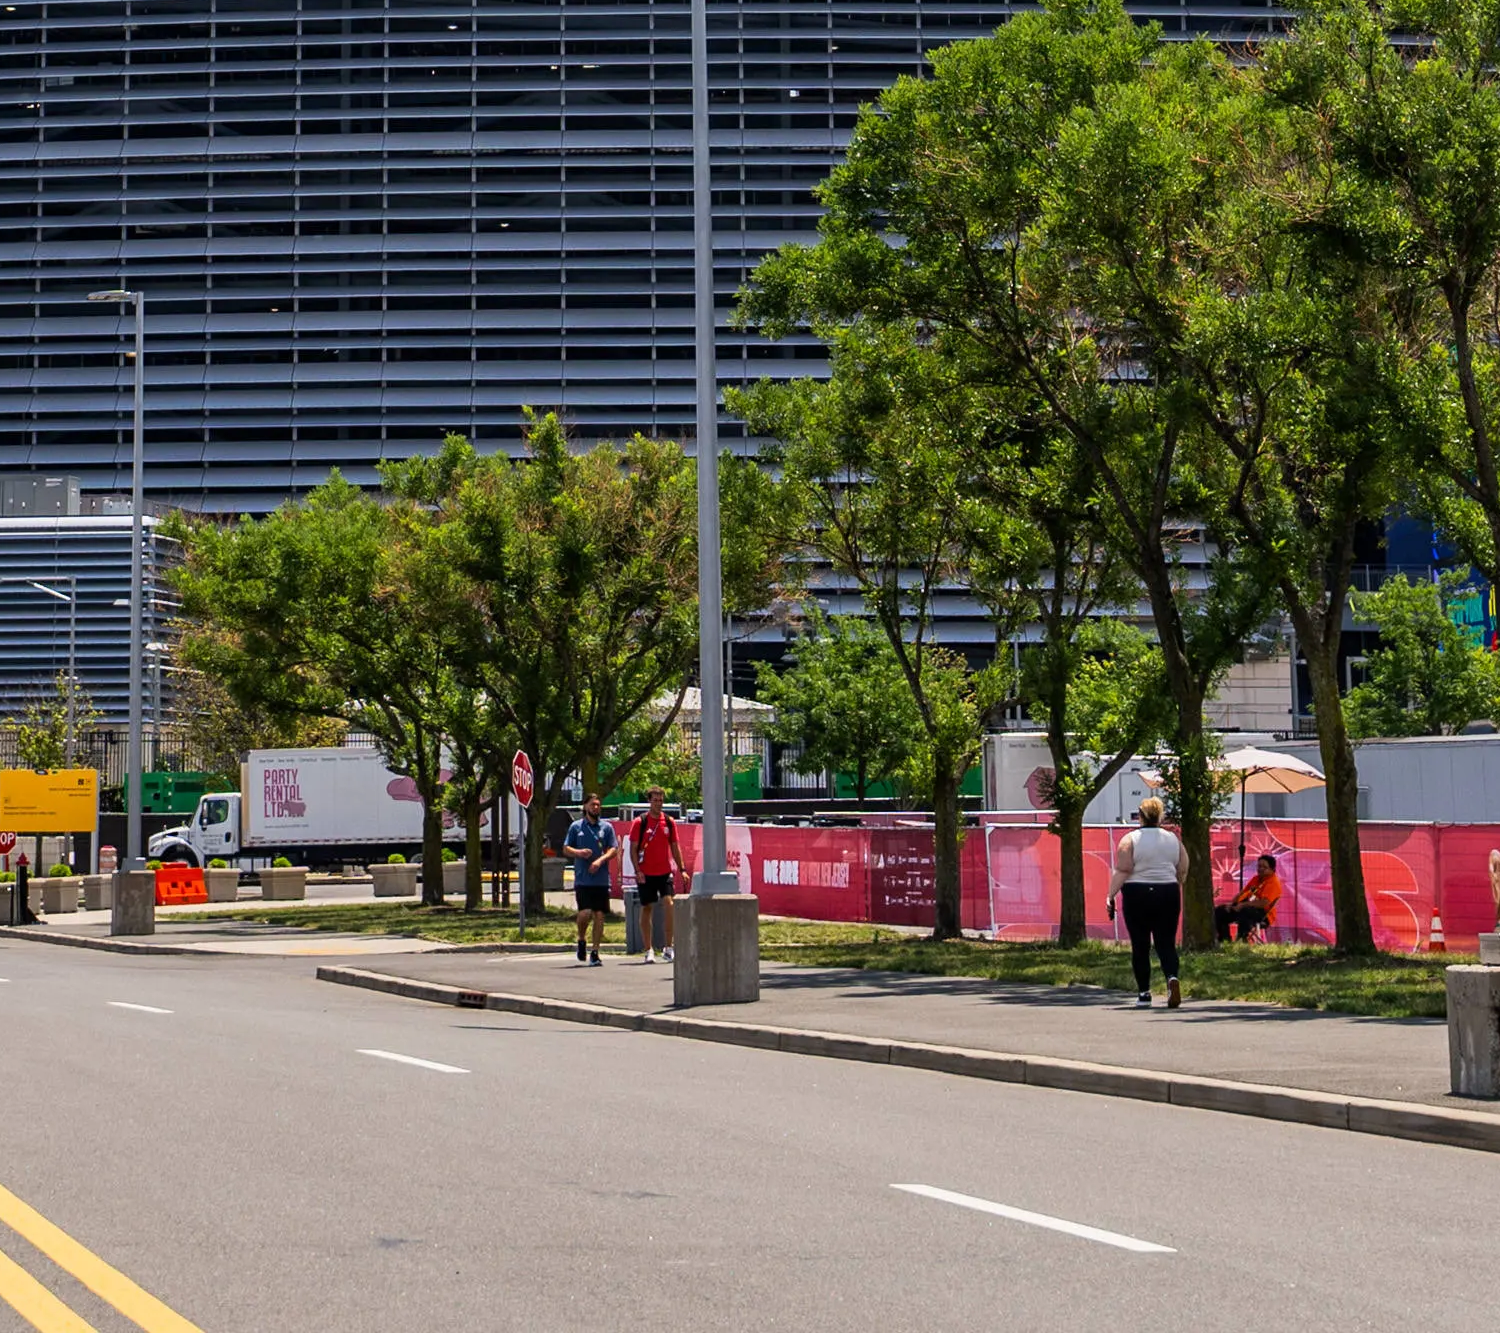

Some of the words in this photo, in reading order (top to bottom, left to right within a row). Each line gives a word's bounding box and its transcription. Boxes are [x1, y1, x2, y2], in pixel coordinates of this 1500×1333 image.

[264, 768, 299, 784] PARTY
[514, 765, 532, 792] STOP
[264, 784, 303, 801] RENTAL
